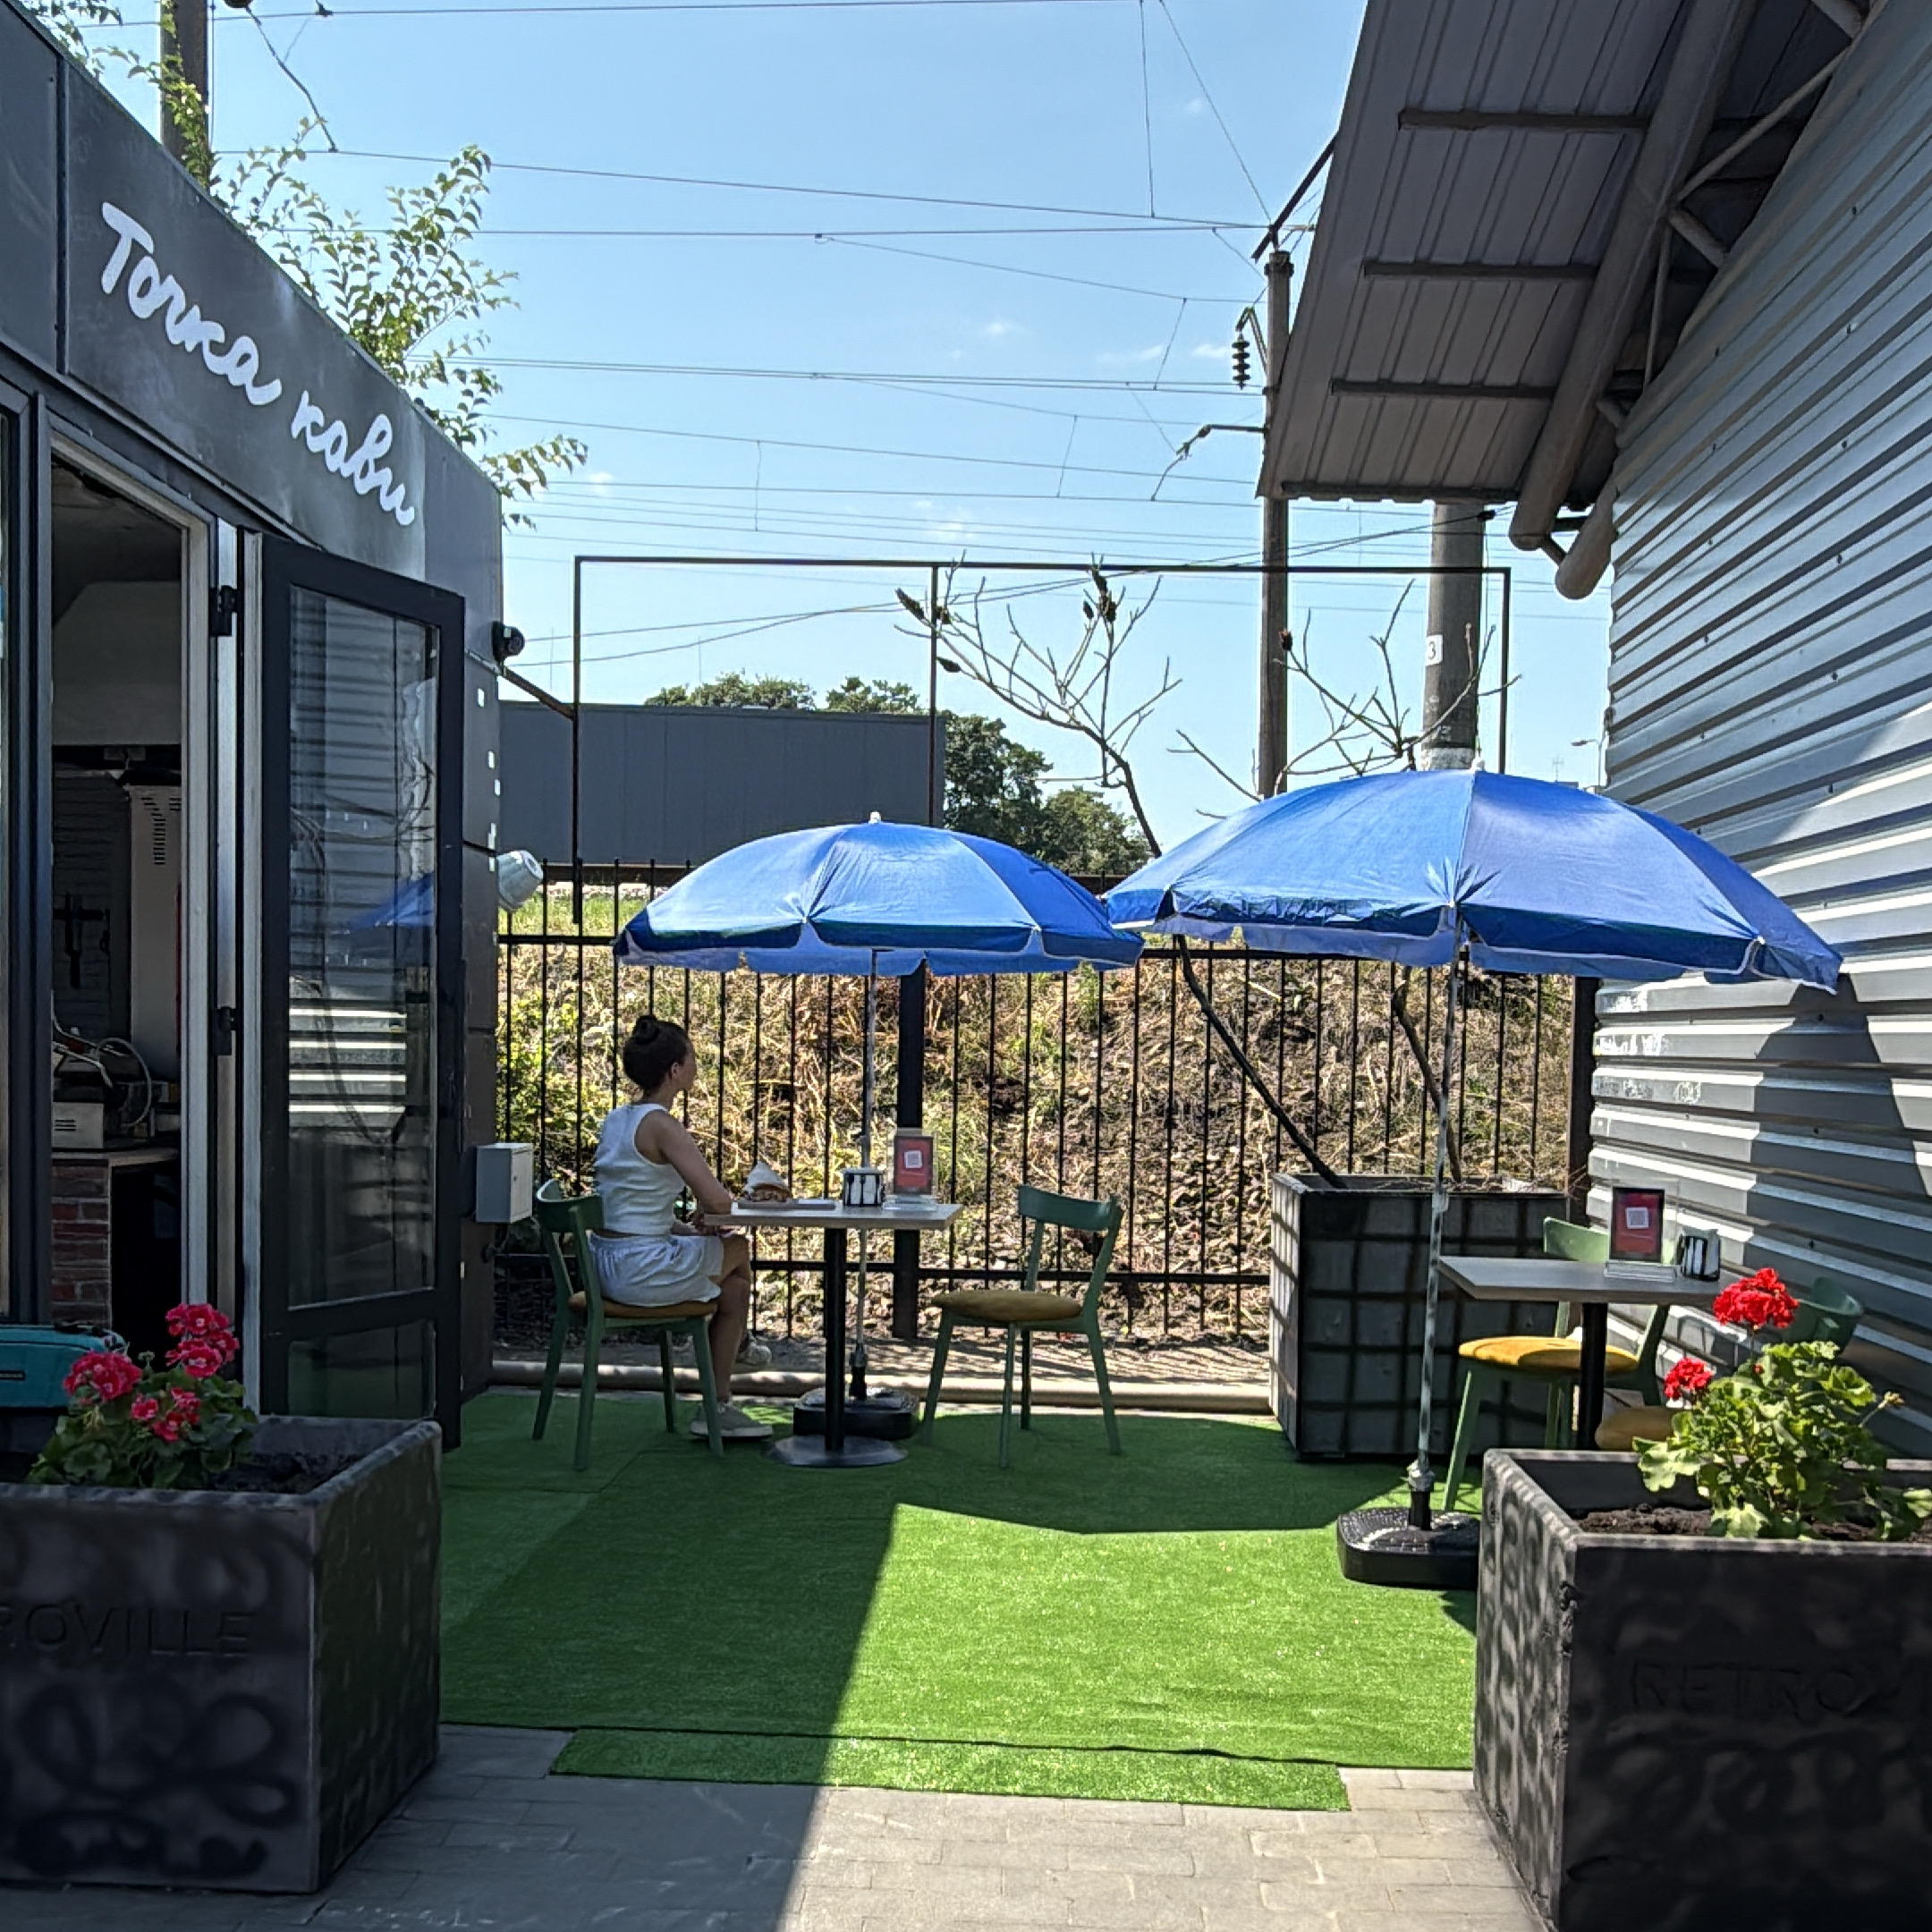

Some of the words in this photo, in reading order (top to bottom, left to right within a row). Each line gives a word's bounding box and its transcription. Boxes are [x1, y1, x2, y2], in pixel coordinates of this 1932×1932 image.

[101, 202, 283, 406] Точка
[291, 390, 415, 526] кави
[1428, 640, 1436, 660] 3
